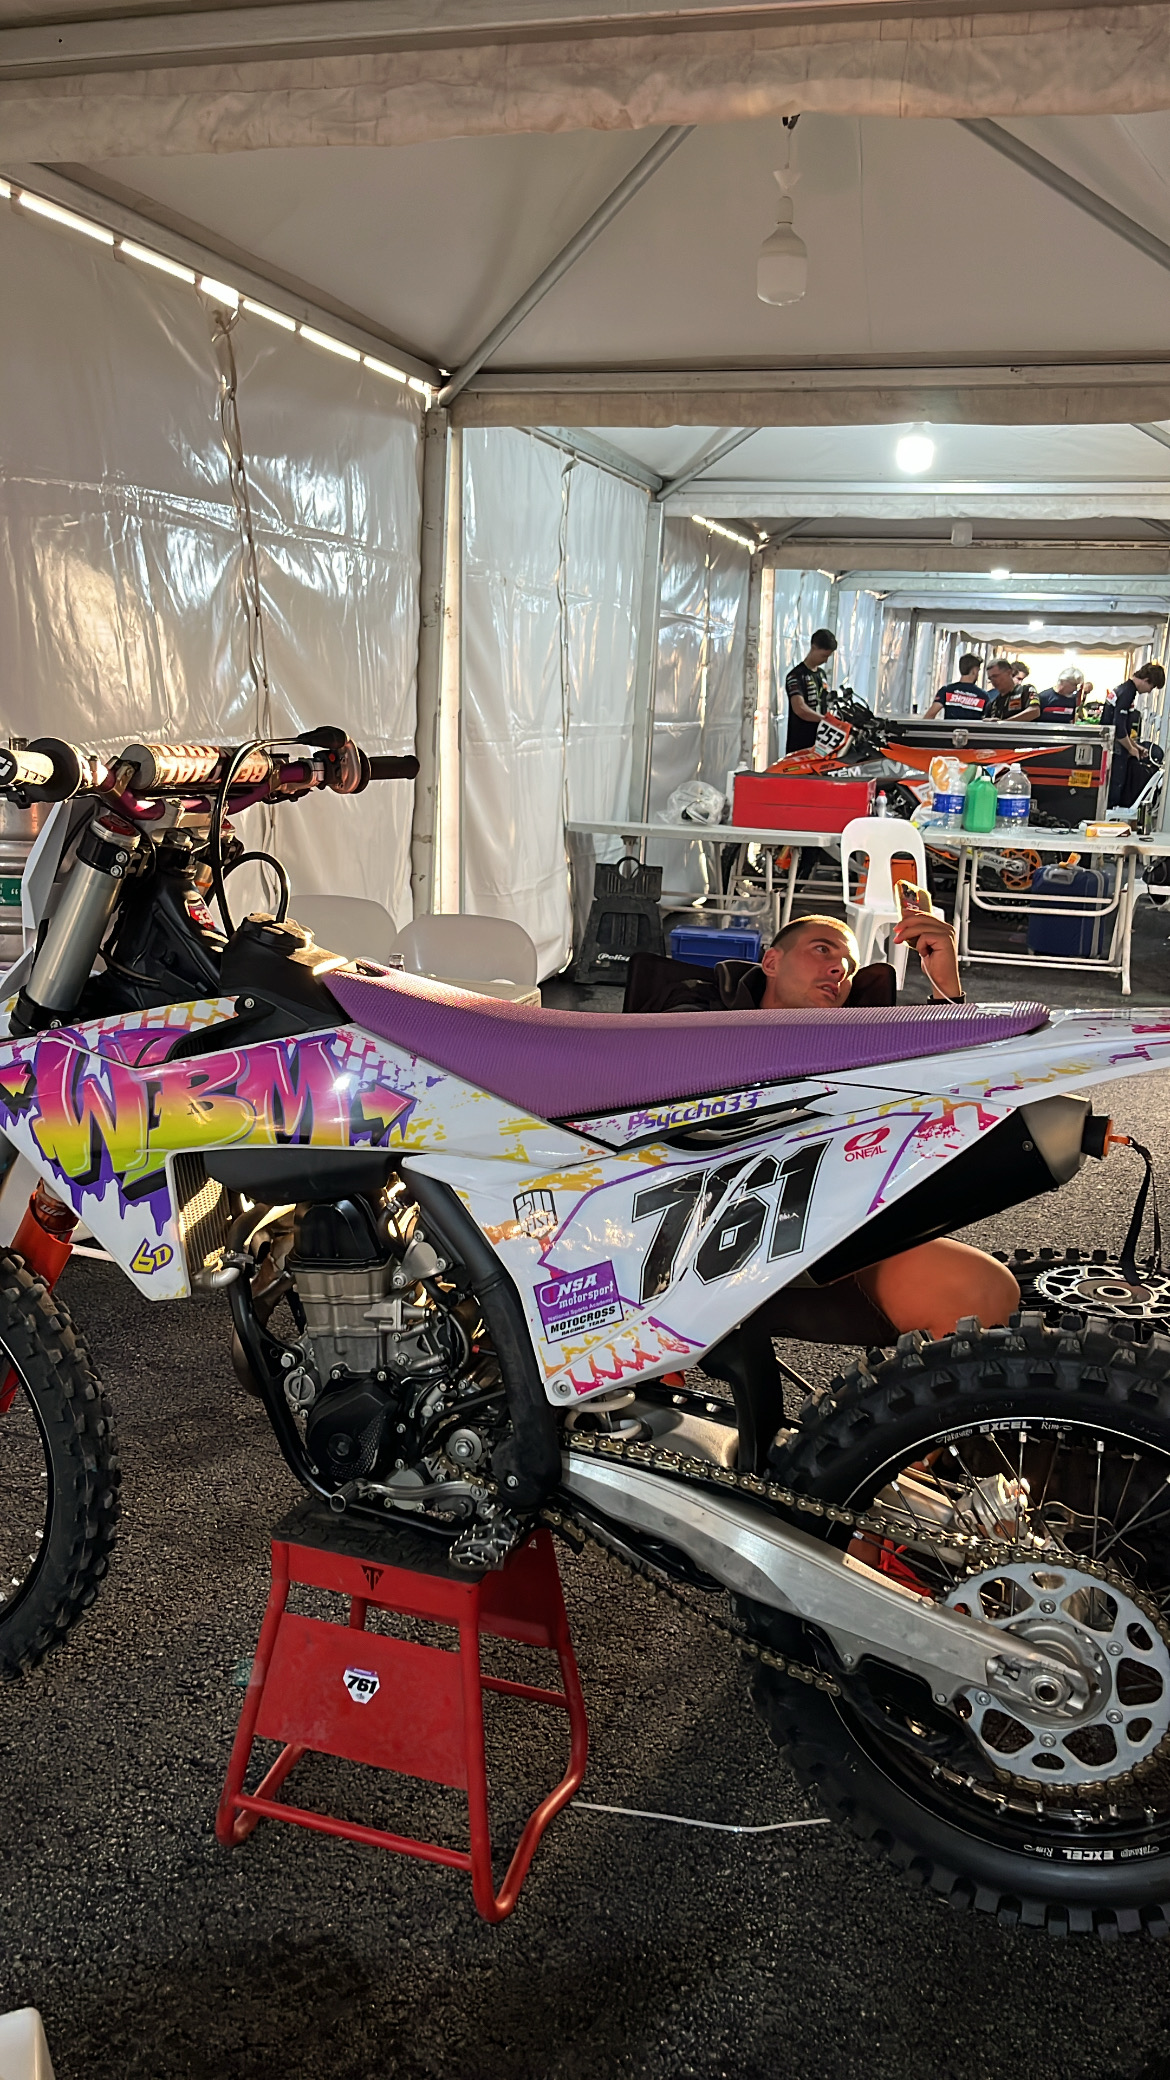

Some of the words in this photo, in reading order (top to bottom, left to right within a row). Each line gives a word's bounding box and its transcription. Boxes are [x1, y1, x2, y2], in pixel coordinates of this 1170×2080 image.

[816, 723, 845, 749] 253
[195, 909, 213, 924] 33
[31, 1029, 352, 1188] WBM
[627, 1092, 761, 1131] Psyccho33
[632, 1138, 834, 1305] 761
[130, 1238, 173, 1275] 6D
[557, 1273, 598, 1297] NSA
[558, 1280, 614, 1309] motorsport
[548, 1310, 570, 1322] National
[570, 1305, 588, 1317] Sports
[588, 1297, 614, 1309] Academy
[550, 1305, 616, 1333] MOTOCROSS
[561, 1324, 585, 1336] RACING
[588, 1318, 606, 1328] TEAM
[979, 1421, 1032, 1433] EXCEL
[347, 1675, 377, 1694] 761
[1062, 1850, 1114, 1861] EXCEL
